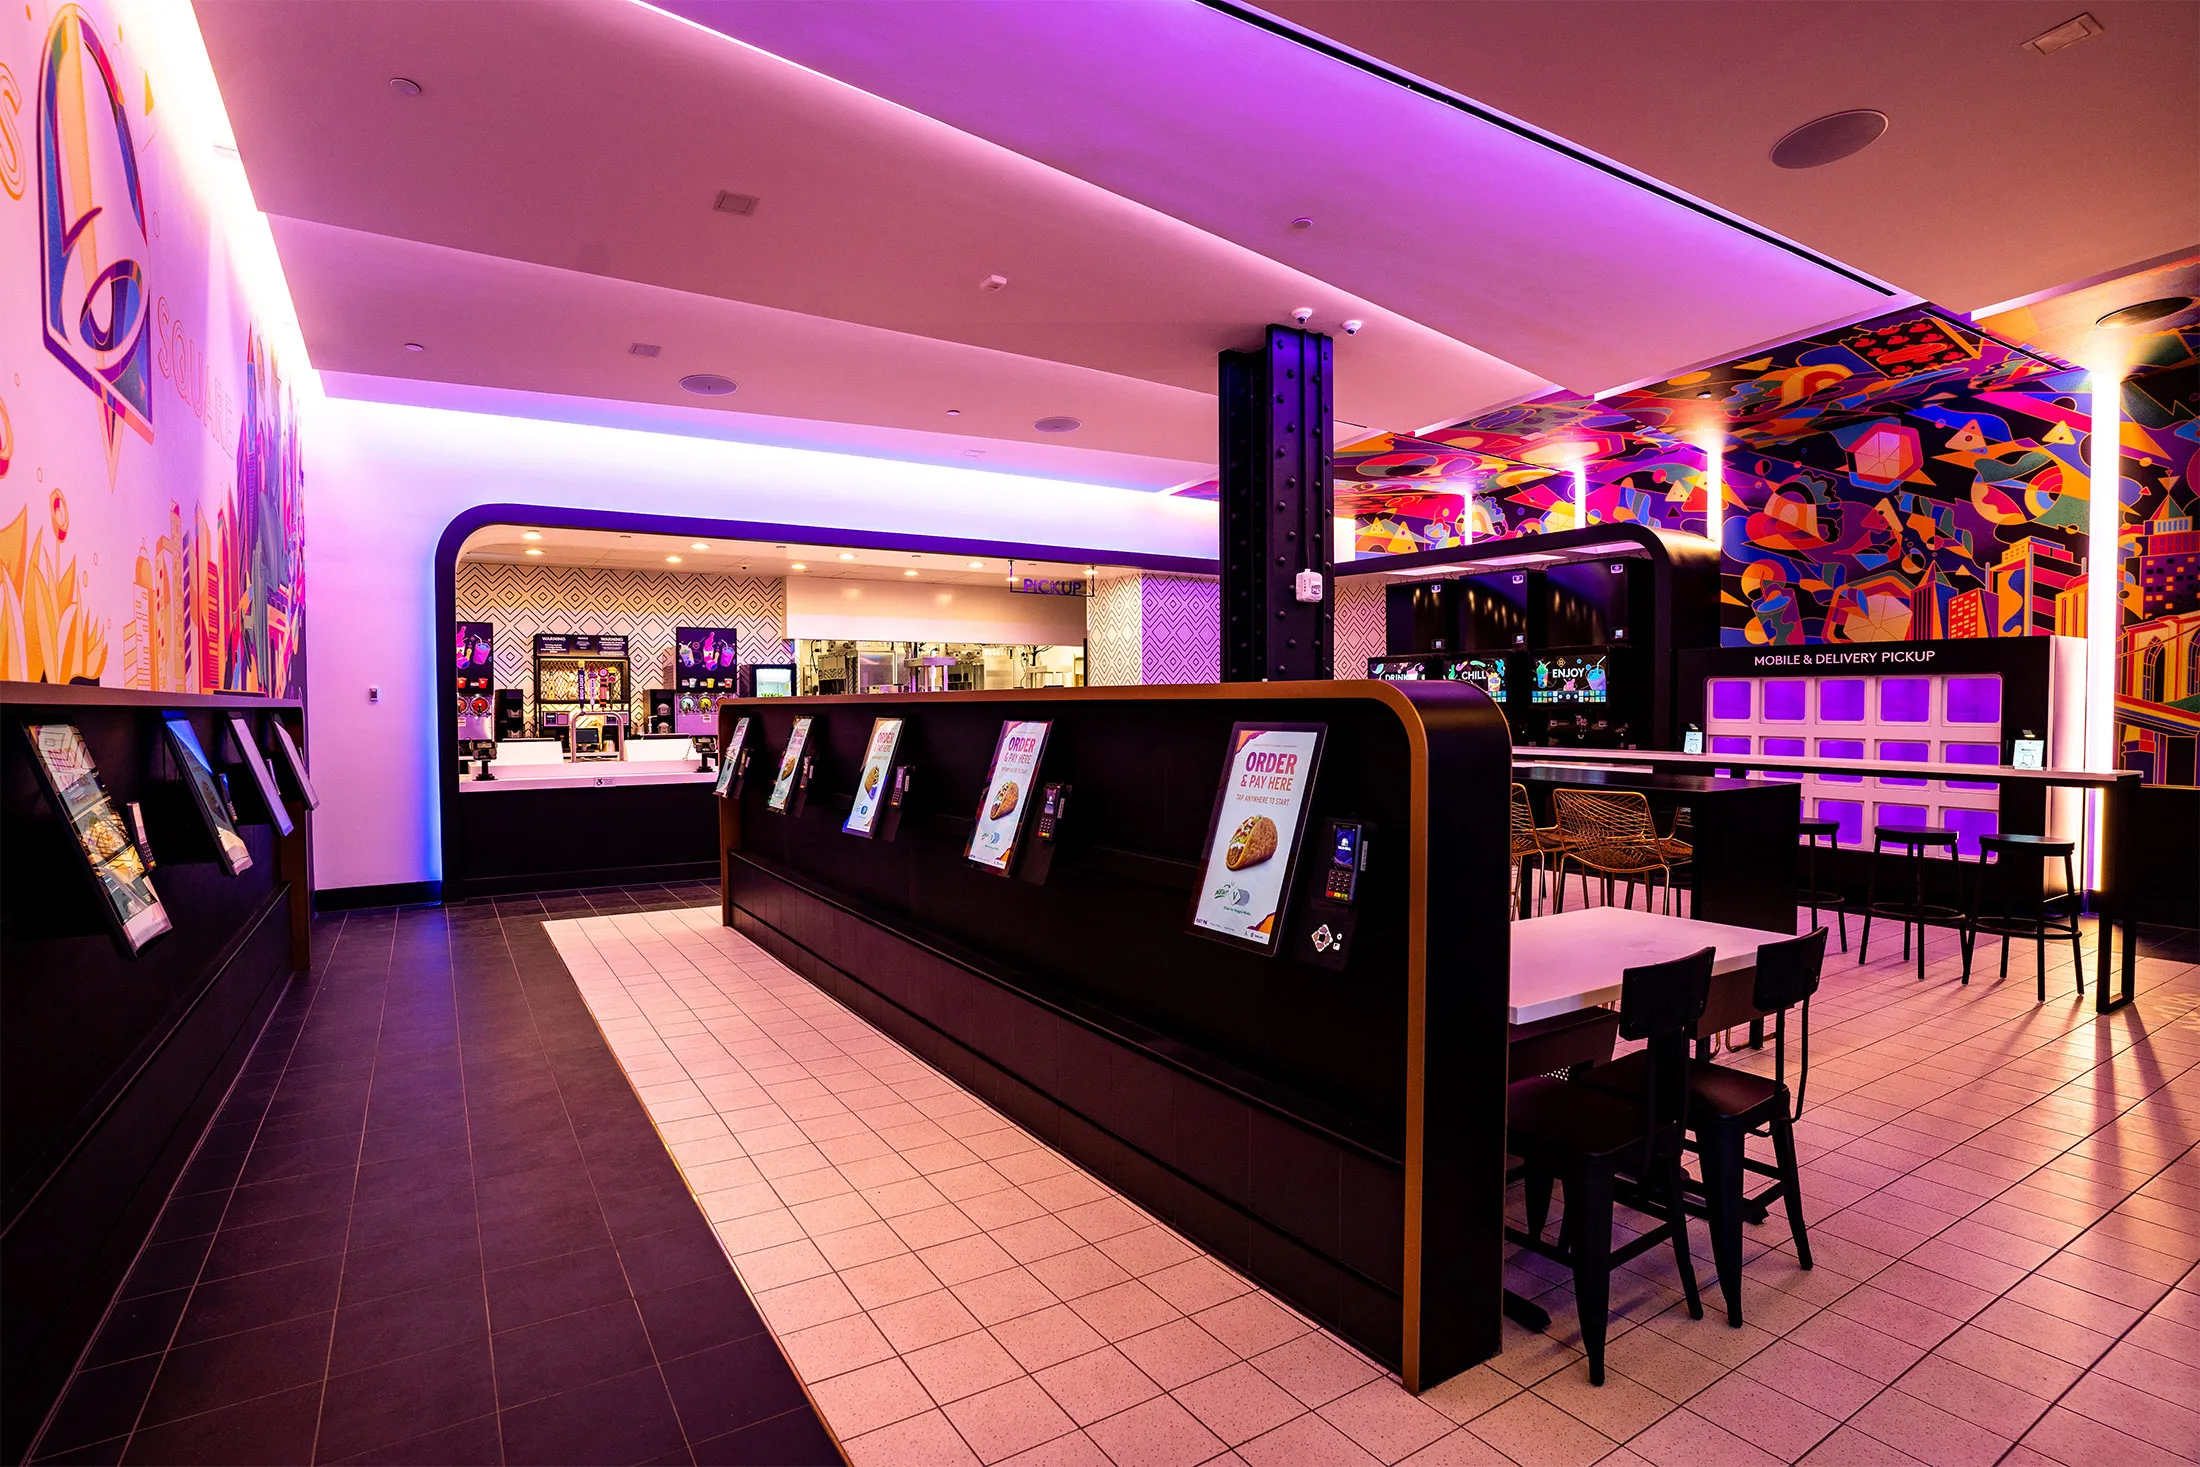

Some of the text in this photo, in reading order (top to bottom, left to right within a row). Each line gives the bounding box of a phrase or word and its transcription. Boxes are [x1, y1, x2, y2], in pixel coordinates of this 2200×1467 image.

[157, 295, 234, 460] SQUARE
[1023, 578, 1082, 596] PICKUP
[1754, 650, 1936, 666] MOBILE & DELIVERY PICKUP
[1461, 670, 1487, 680] CHILL
[1552, 667, 1585, 678] ENJOY
[1008, 737, 1036, 753] ORDER
[1008, 753, 1019, 763] PAY
[1018, 754, 1032, 764] HERE
[1245, 751, 1298, 775] ORDER
[1240, 774, 1293, 791] & PAY HERE
[1244, 795, 1269, 804] ANYWHERE
[1275, 798, 1290, 806] START
